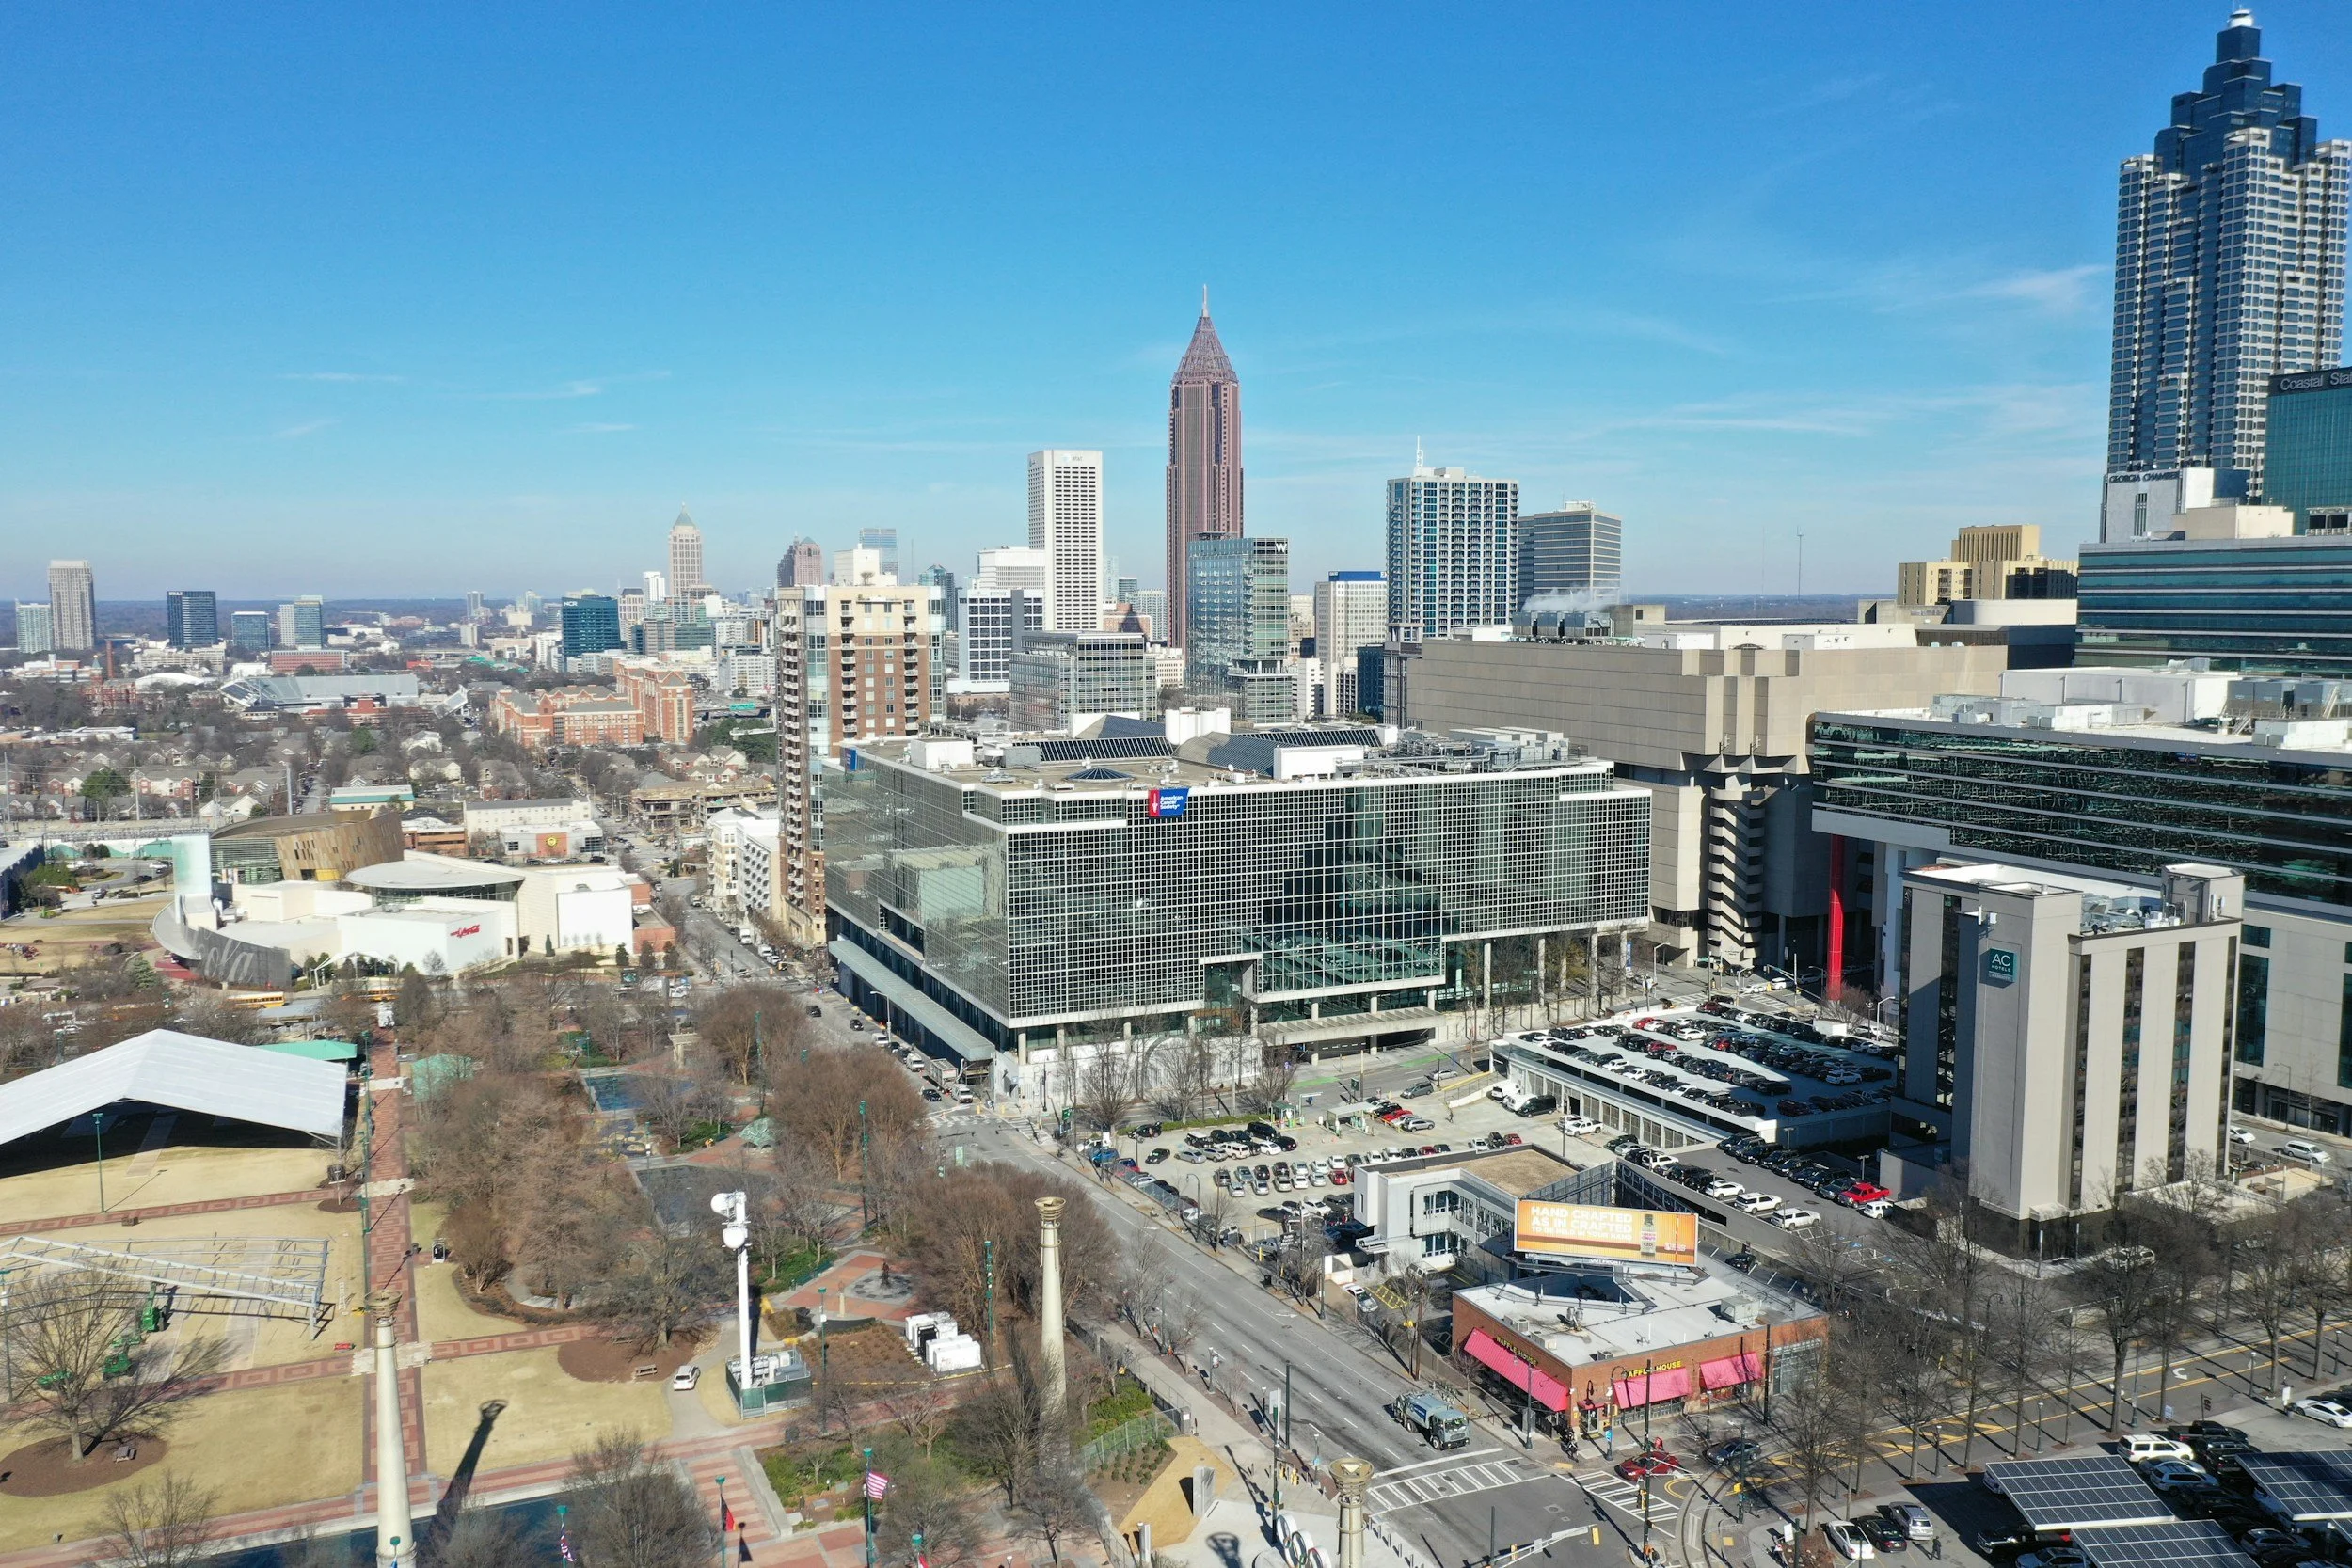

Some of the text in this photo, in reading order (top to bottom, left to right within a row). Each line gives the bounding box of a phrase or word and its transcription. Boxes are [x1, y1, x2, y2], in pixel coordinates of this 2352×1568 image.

[2280, 374, 2323, 390] Coastal
[2109, 473, 2141, 484] GEORGIA
[1275, 543, 1287, 553] W
[1992, 953, 2011, 967] AC
[1531, 1206, 1632, 1223] HAND CRAFTED
[1532, 1216, 1632, 1233] AS IN CRAFTED
[1496, 1335, 1517, 1354] WAFFLE
[1656, 1360, 1681, 1371] HOUSE
